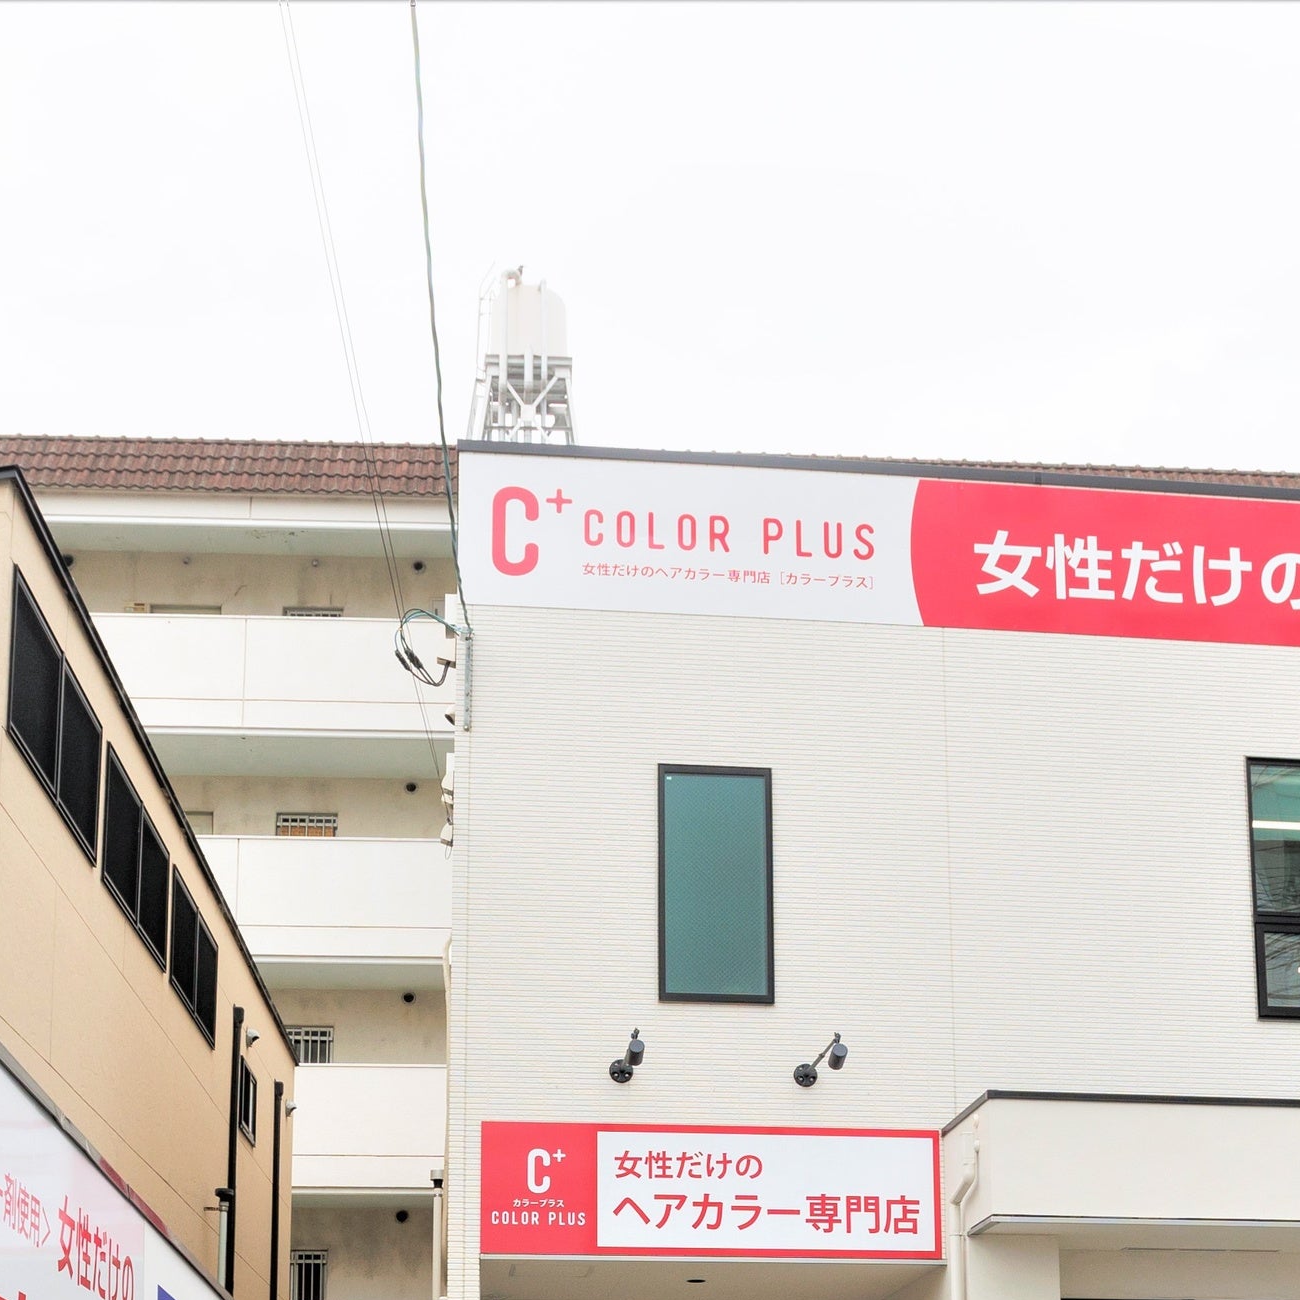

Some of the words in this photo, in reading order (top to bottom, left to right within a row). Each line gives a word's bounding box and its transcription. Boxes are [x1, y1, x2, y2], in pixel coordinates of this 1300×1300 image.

[583, 509, 731, 554] COLOR
[763, 517, 876, 561] PLUS
[582, 562, 771, 585] 女性だけのヘアカラー専門店
[614, 1150, 763, 1180] 女性だけの
[513, 1198, 565, 1208] カラープラス
[612, 1192, 921, 1235] ヘアカラー専門店
[491, 1210, 540, 1226] COLOR
[548, 1211, 586, 1226] PLUS
